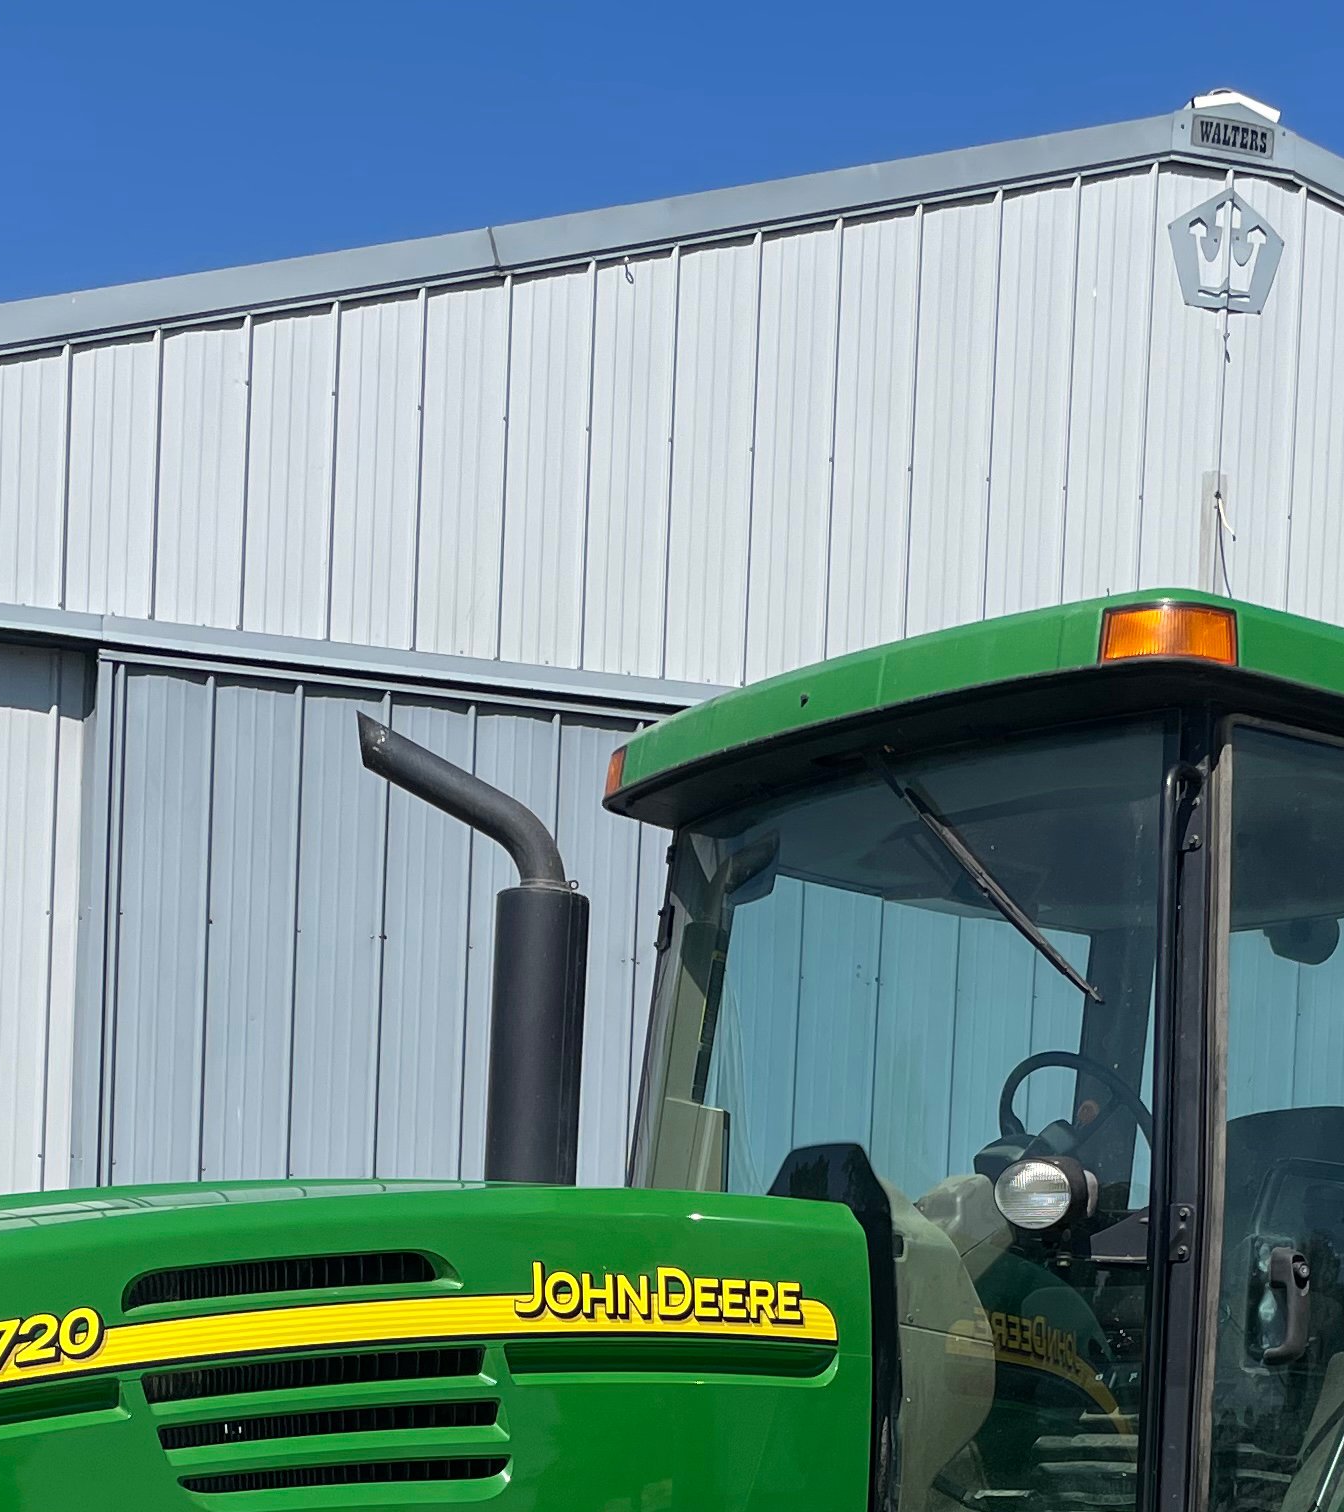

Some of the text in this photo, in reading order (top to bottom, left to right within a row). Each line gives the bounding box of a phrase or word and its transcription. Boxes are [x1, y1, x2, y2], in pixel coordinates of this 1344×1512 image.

[1199, 120, 1268, 154] WALTERS
[514, 1260, 804, 1325] JOHN DEERE
